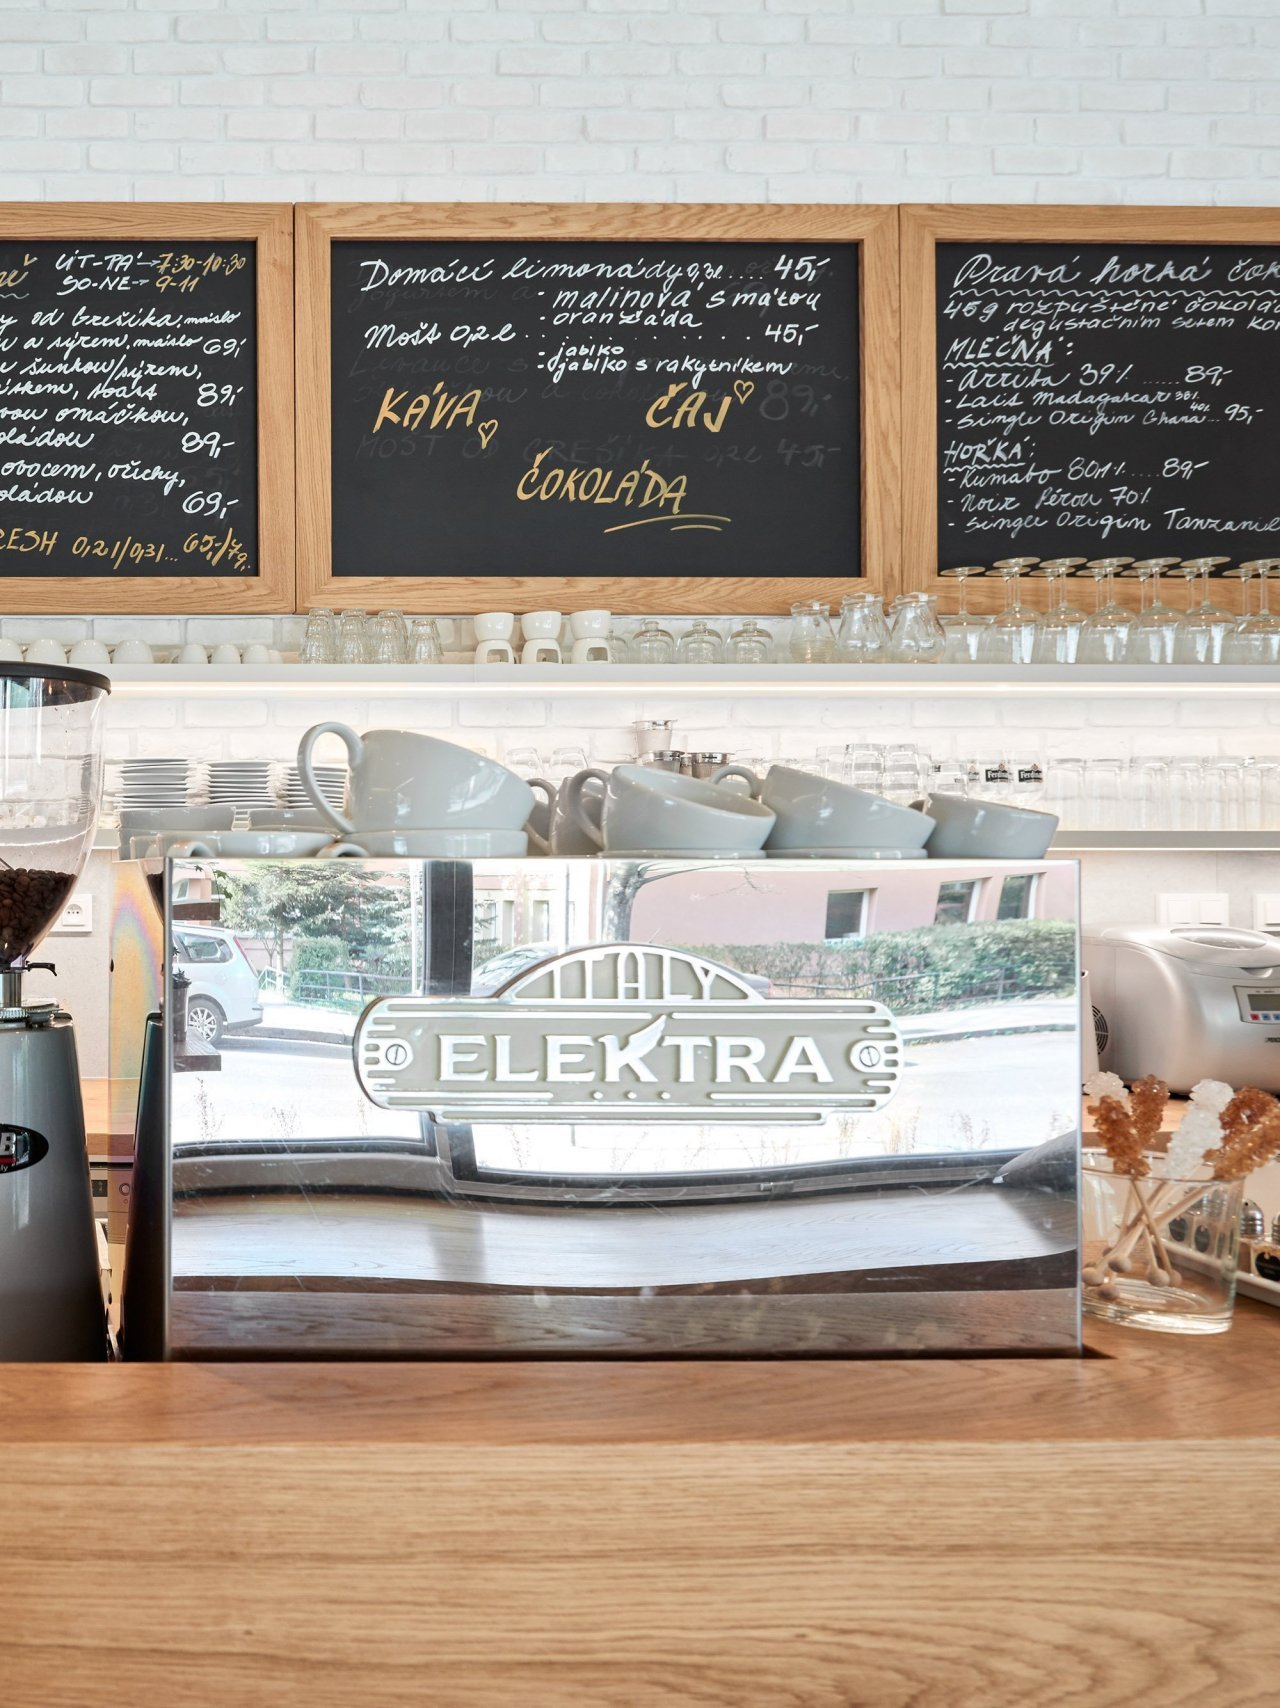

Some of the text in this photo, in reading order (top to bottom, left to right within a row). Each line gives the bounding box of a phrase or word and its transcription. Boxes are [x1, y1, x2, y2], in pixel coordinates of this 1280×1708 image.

[155, 275, 200, 293] 9-11
[360, 258, 495, 291] Domácí
[501, 256, 683, 293] limonády
[953, 253, 1082, 288] Pravá
[1089, 255, 1212, 285] horká
[552, 281, 821, 311] malinová s mátou
[31, 308, 65, 327] od
[553, 309, 702, 328] oranžáda
[1003, 315, 1160, 340] degustačním
[1171, 316, 1235, 329] setem
[23, 337, 43, 349] a
[133, 335, 203, 348] máslo
[364, 321, 442, 349] Mošt
[547, 342, 625, 372] jablko
[553, 355, 792, 390] jablko s rakytníkem
[372, 381, 732, 433] KÁVA ČAJ
[1049, 410, 1135, 435] Origin
[1142, 409, 1206, 425] Ghana
[516, 446, 687, 514] ČOKOLÁDA
[959, 462, 1062, 489] Kumabo
[1035, 487, 1102, 510] Pérou
[1056, 511, 1151, 539] Origin
[552, 952, 717, 1000] ITALY
[437, 1014, 833, 1083] ELEKTRA
